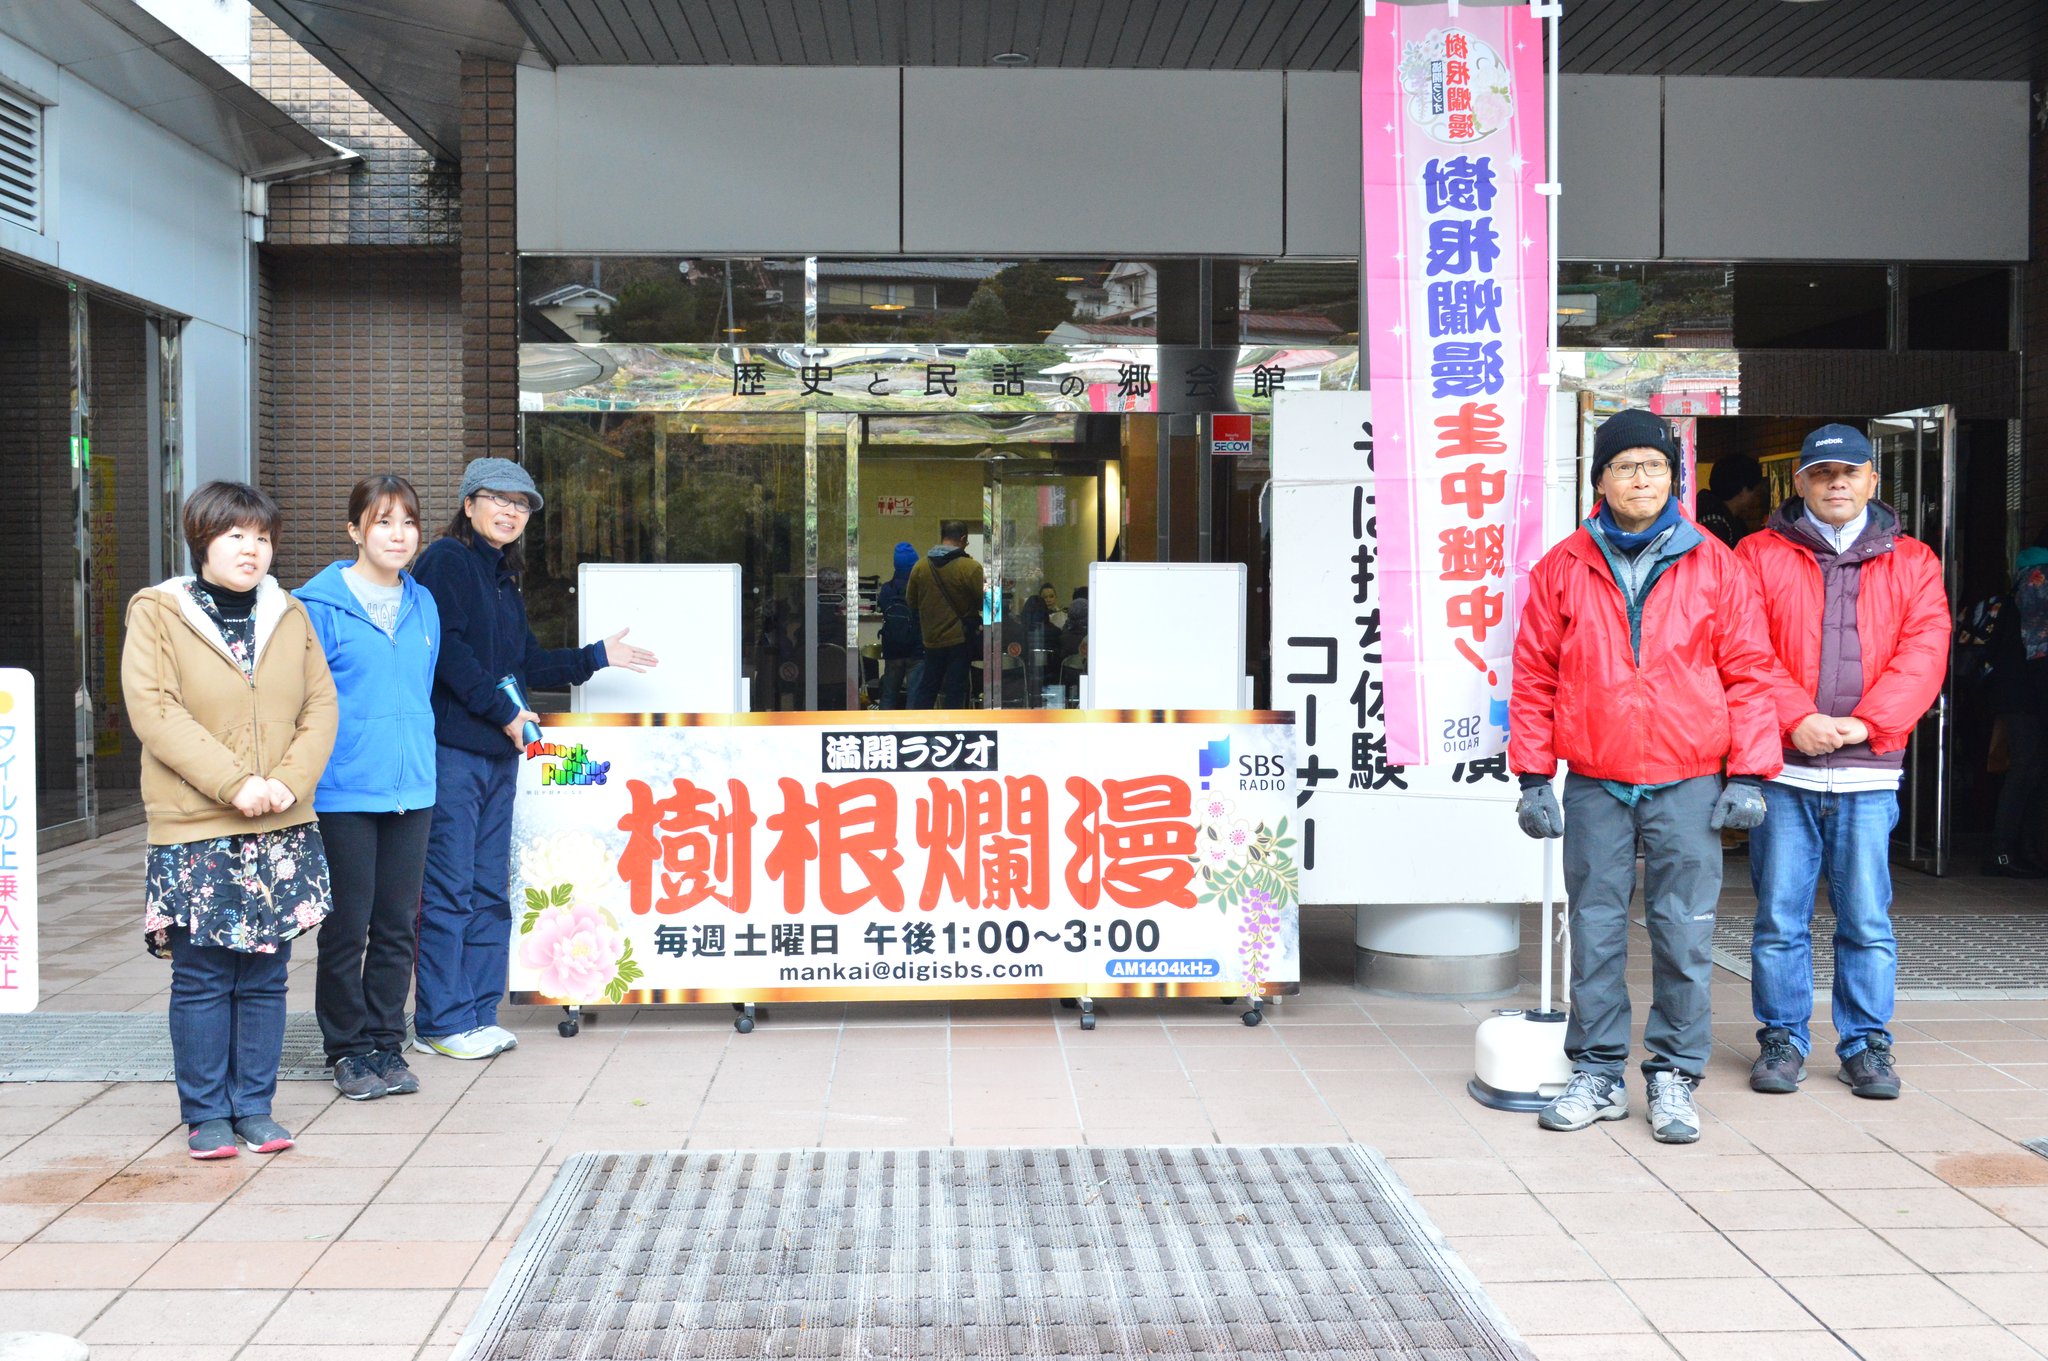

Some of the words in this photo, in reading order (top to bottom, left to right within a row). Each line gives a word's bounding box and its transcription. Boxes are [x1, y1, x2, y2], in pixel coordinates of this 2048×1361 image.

[732, 363, 1287, 399] 歴史と民話の郷会館
[1214, 441, 1250, 451] SECOM
[1815, 437, 1843, 447] Reebok
[895, 498, 913, 508] トイレ
[527, 741, 588, 764] Knock
[826, 733, 996, 771] 満開ラジオ
[1287, 636, 1339, 871] コーナー
[541, 763, 608, 786] Future
[1238, 754, 1286, 778] SBS
[1239, 778, 1286, 791] RADIO
[617, 774, 1198, 916] 樹根爛漫
[654, 922, 839, 958] 毎週土曜日
[779, 961, 1044, 982] mankai@digisbs.com
[1112, 960, 1213, 977] AM1404kHz
